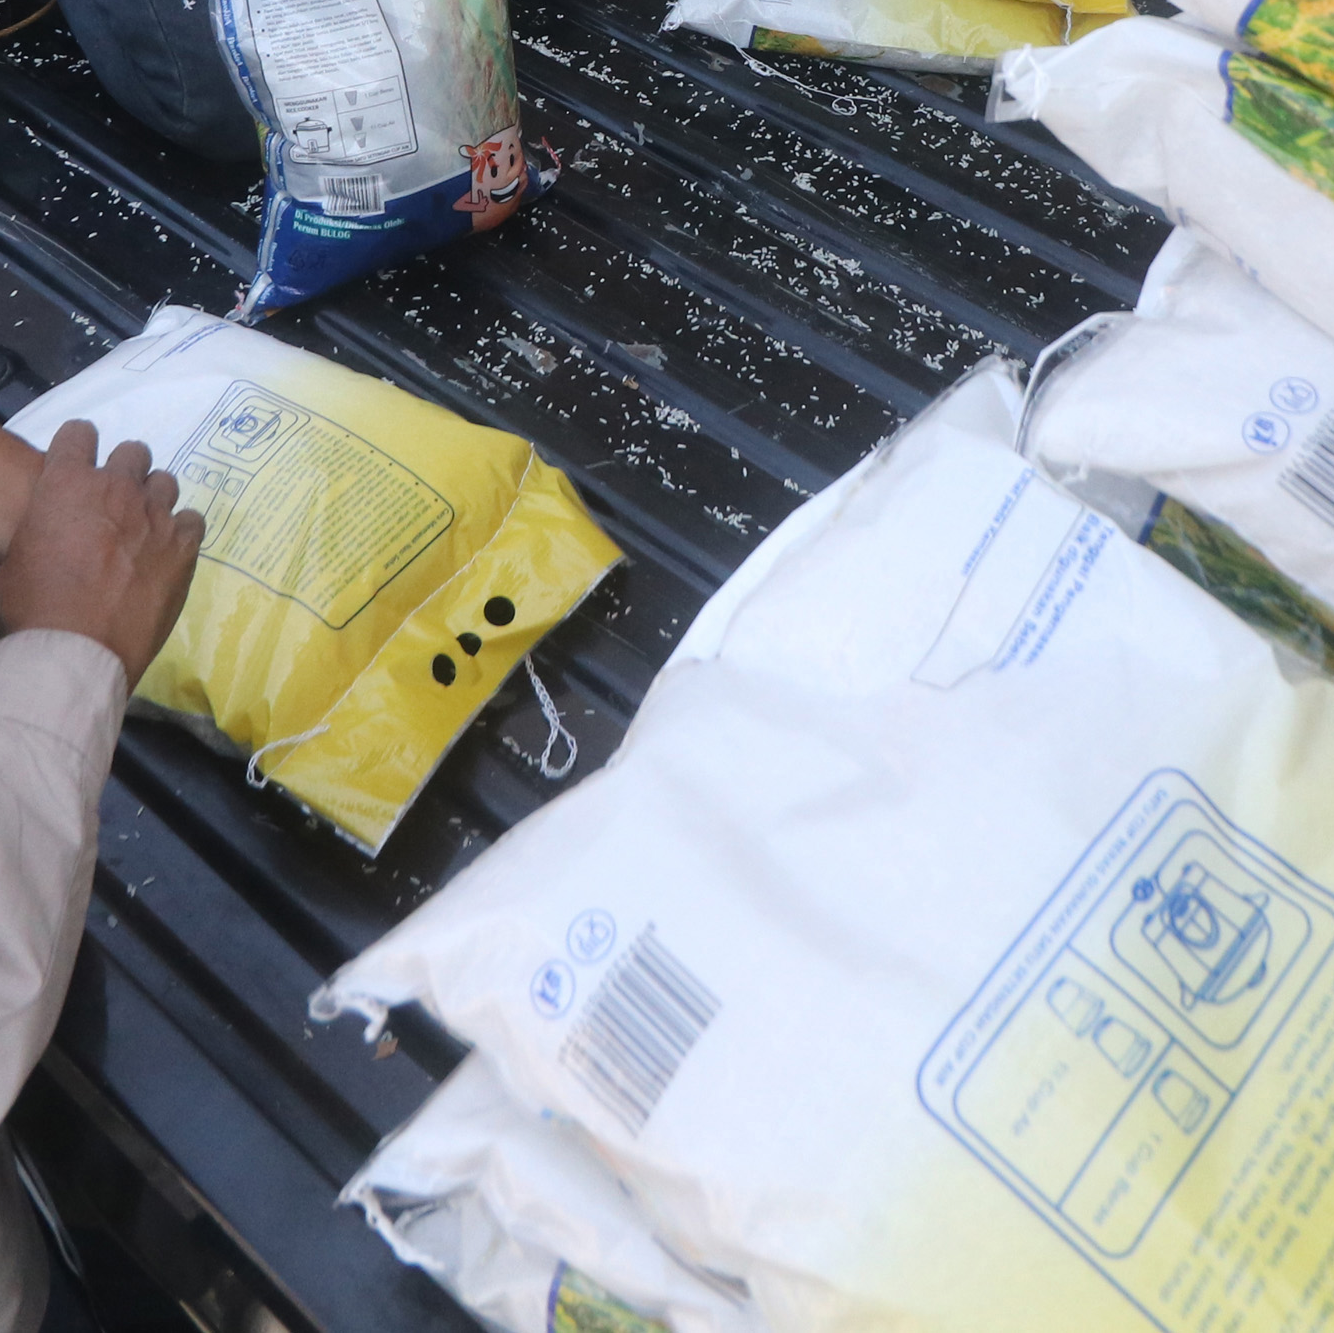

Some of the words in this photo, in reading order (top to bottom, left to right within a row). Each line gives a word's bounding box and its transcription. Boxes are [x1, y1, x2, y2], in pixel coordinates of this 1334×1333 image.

[291, 221, 319, 235] Perum
[319, 227, 351, 241] BULOG
[990, 493, 1015, 524] pada
[1072, 511, 1101, 547] Baik
[958, 522, 998, 579] Kemasan
[1073, 521, 1116, 580] Tanggal
[1027, 541, 1082, 620] digunakan
[947, 1027, 981, 1065] CUP
[930, 1058, 958, 1089] AIR
[1023, 1076, 1058, 1117] Cup
[1120, 1138, 1158, 1181] Cup
[1090, 1175, 1134, 1230] Beras
